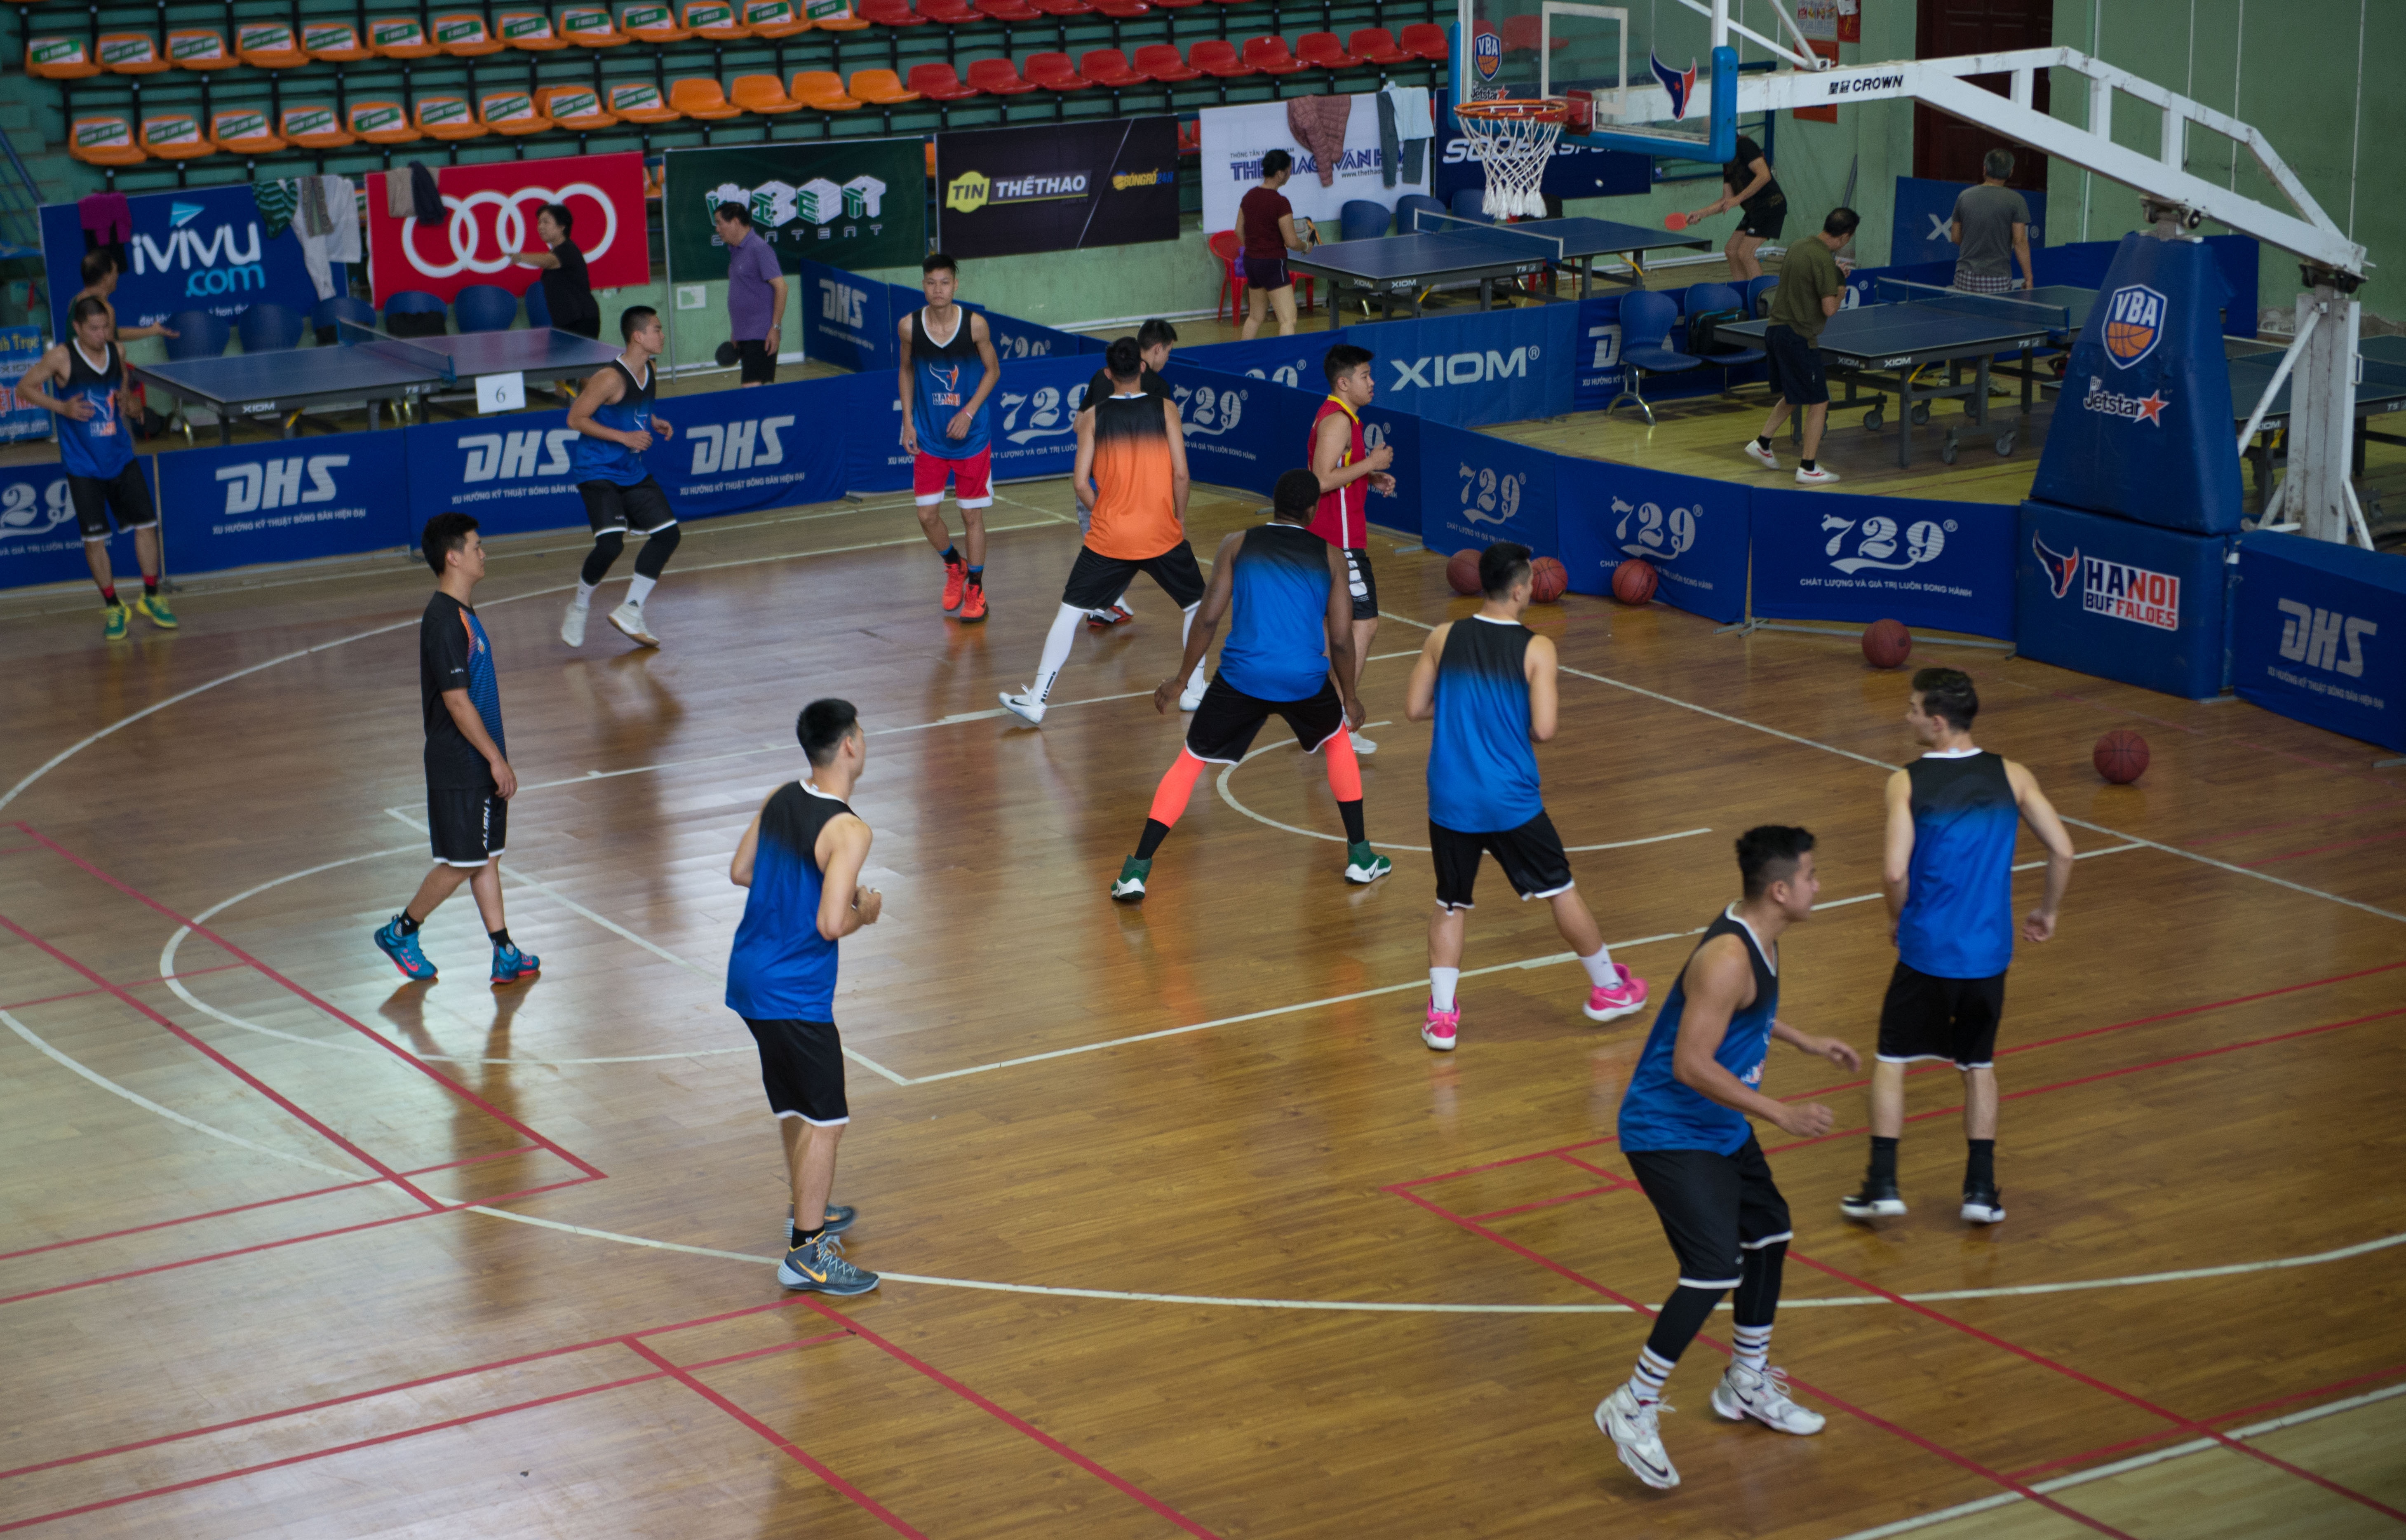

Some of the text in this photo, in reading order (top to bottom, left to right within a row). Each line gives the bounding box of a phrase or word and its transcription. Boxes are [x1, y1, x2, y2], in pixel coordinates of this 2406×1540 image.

[1478, 36, 1499, 56] VBA
[1852, 75, 1904, 92] CROWN
[1471, 87, 1498, 101] Jetstar
[952, 183, 985, 200] TIN
[186, 264, 266, 298] .com
[1353, 278, 1371, 288] XIOM
[1391, 278, 1417, 289] XIOM
[819, 278, 867, 329] DHS
[2114, 291, 2158, 327] VBA
[1838, 356, 1859, 368] XIOM
[1884, 356, 1912, 367] XIOM
[1582, 378, 1591, 387] XU
[495, 385, 506, 404] 6
[2085, 389, 2141, 416] Jetstar
[242, 401, 275, 413] XIOM
[458, 428, 580, 483] DHS
[686, 415, 795, 476] DHS
[1000, 449, 1024, 459] LƯỢNG
[1036, 446, 1048, 454] GIÁ
[1190, 441, 1197, 449] VÀ
[1215, 445, 1228, 454] LUÔN
[1229, 448, 1242, 457] SONG
[1243, 451, 1256, 461] HÀNH
[888, 456, 897, 465] XU
[216, 454, 350, 515] DHS
[679, 472, 805, 496] XU HƯỚNG KỸ THUẬT BÓNG BÀN HIỆN ĐẠI
[452, 495, 462, 505] XU
[463, 491, 491, 502] HƯỚNG
[492, 488, 502, 499] KỸ
[503, 488, 527, 498] THUẬT
[528, 486, 549, 496] BÓNG
[550, 484, 566, 494] BÀN
[212, 508, 366, 535] XU HƯỚNG KỸ THUẬT BÓNG BÀN HIỆN ĐẠI
[1824, 579, 1854, 589] LƯỢNG
[1855, 579, 1867, 587] VÀ
[1868, 579, 1883, 588] GIÁ
[1883, 581, 1897, 590] TRỊ
[1898, 580, 1922, 590] LUÔN
[1923, 583, 1948, 594] SONG
[1948, 586, 1972, 597] HÀNH
[2086, 559, 2177, 609] HANOI
[2085, 592, 2176, 629] BUFFALOES
[2277, 598, 2378, 678] DHS
